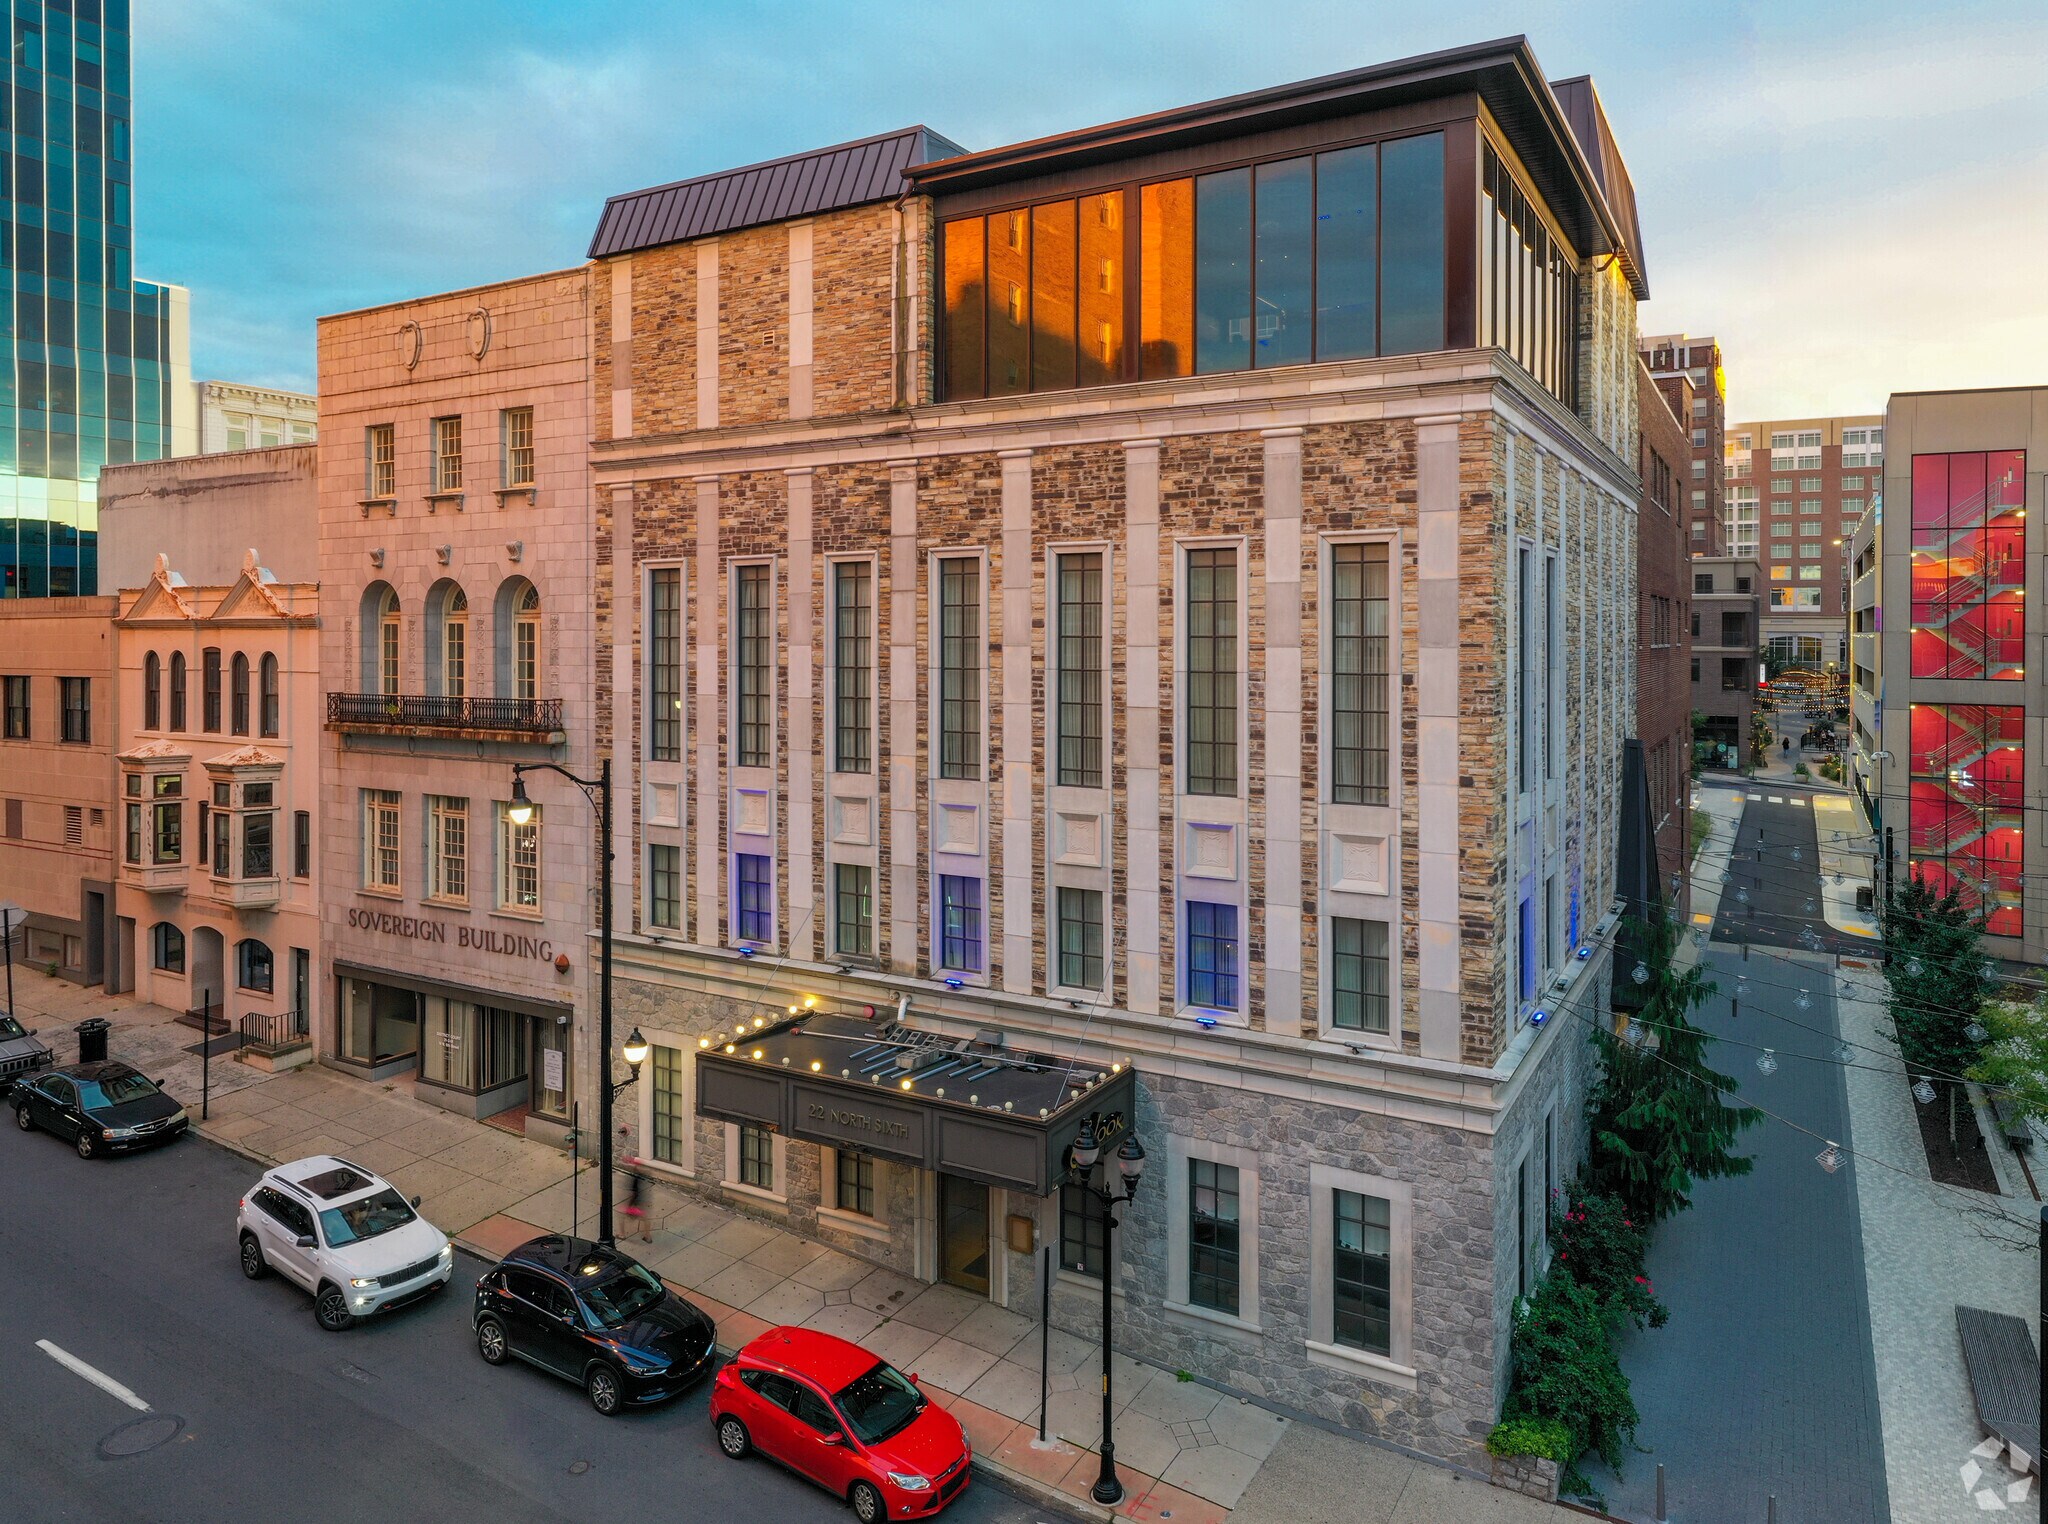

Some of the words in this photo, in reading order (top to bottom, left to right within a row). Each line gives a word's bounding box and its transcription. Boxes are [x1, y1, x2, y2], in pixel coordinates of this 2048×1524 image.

[348, 908, 446, 944] SOVEREIGN
[458, 926, 553, 962] BUILDING
[808, 1103, 825, 1120] 22
[830, 1109, 871, 1131] NORTH
[874, 1118, 909, 1139] SIXTH
